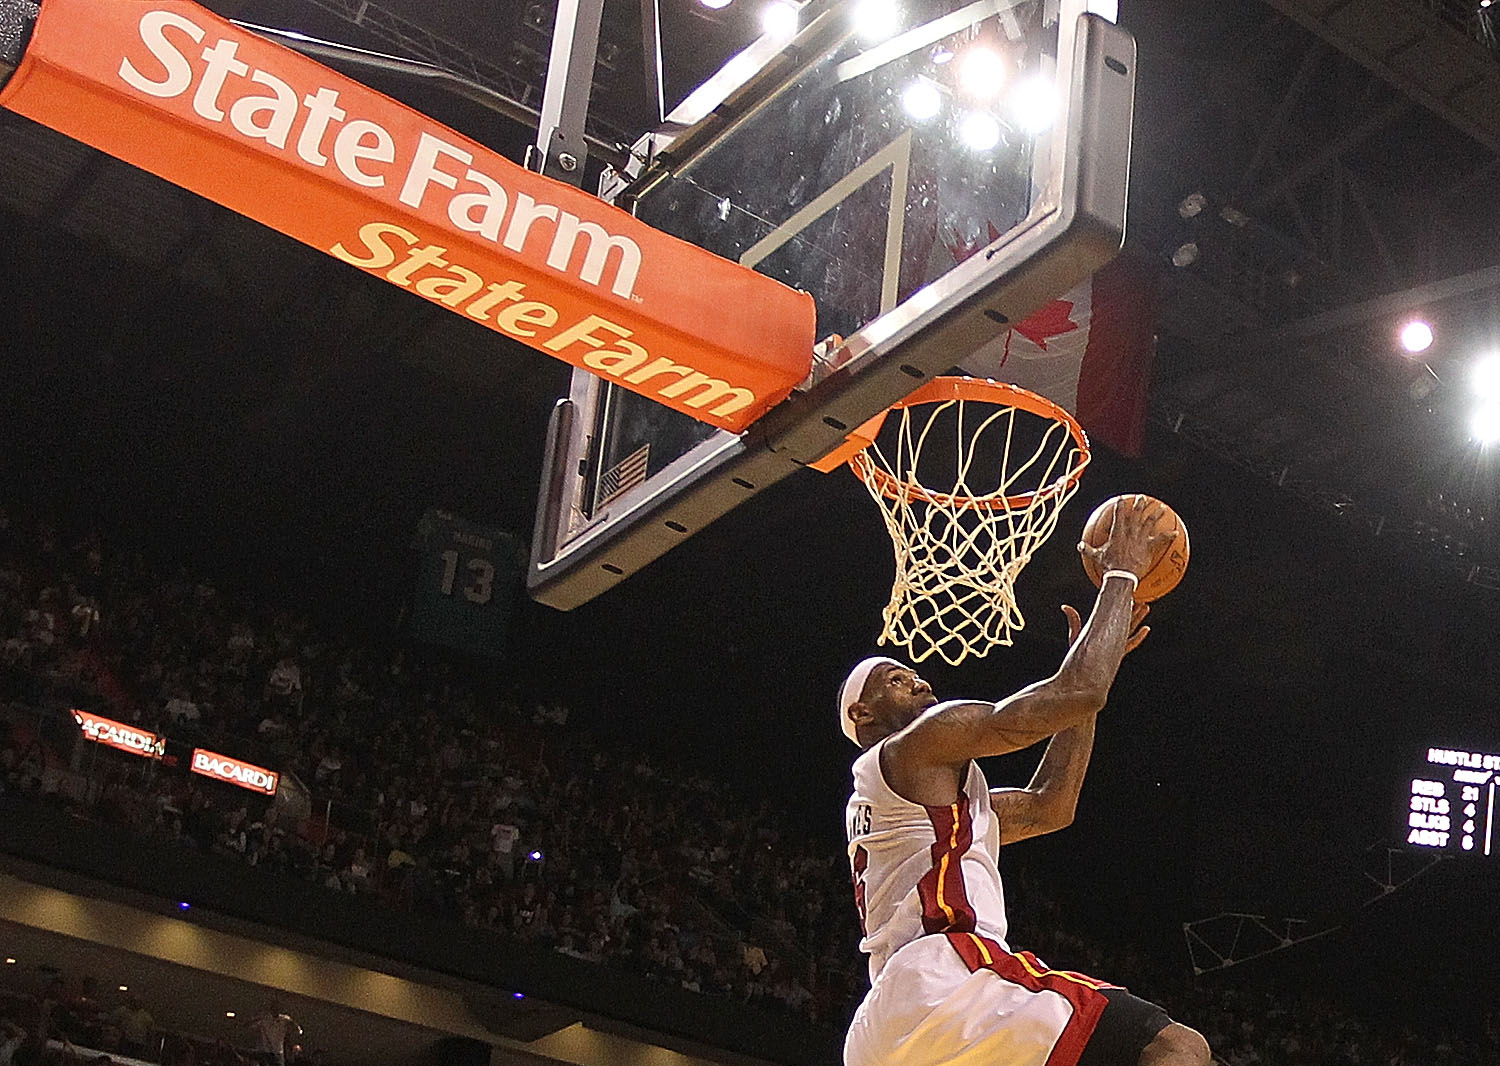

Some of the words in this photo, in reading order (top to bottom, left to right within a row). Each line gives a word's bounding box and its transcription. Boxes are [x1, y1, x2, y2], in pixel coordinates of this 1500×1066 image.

[1426, 747, 1483, 769] HUSTLE
[194, 753, 275, 790] BACARDI
[1409, 795, 1451, 815] STLS
